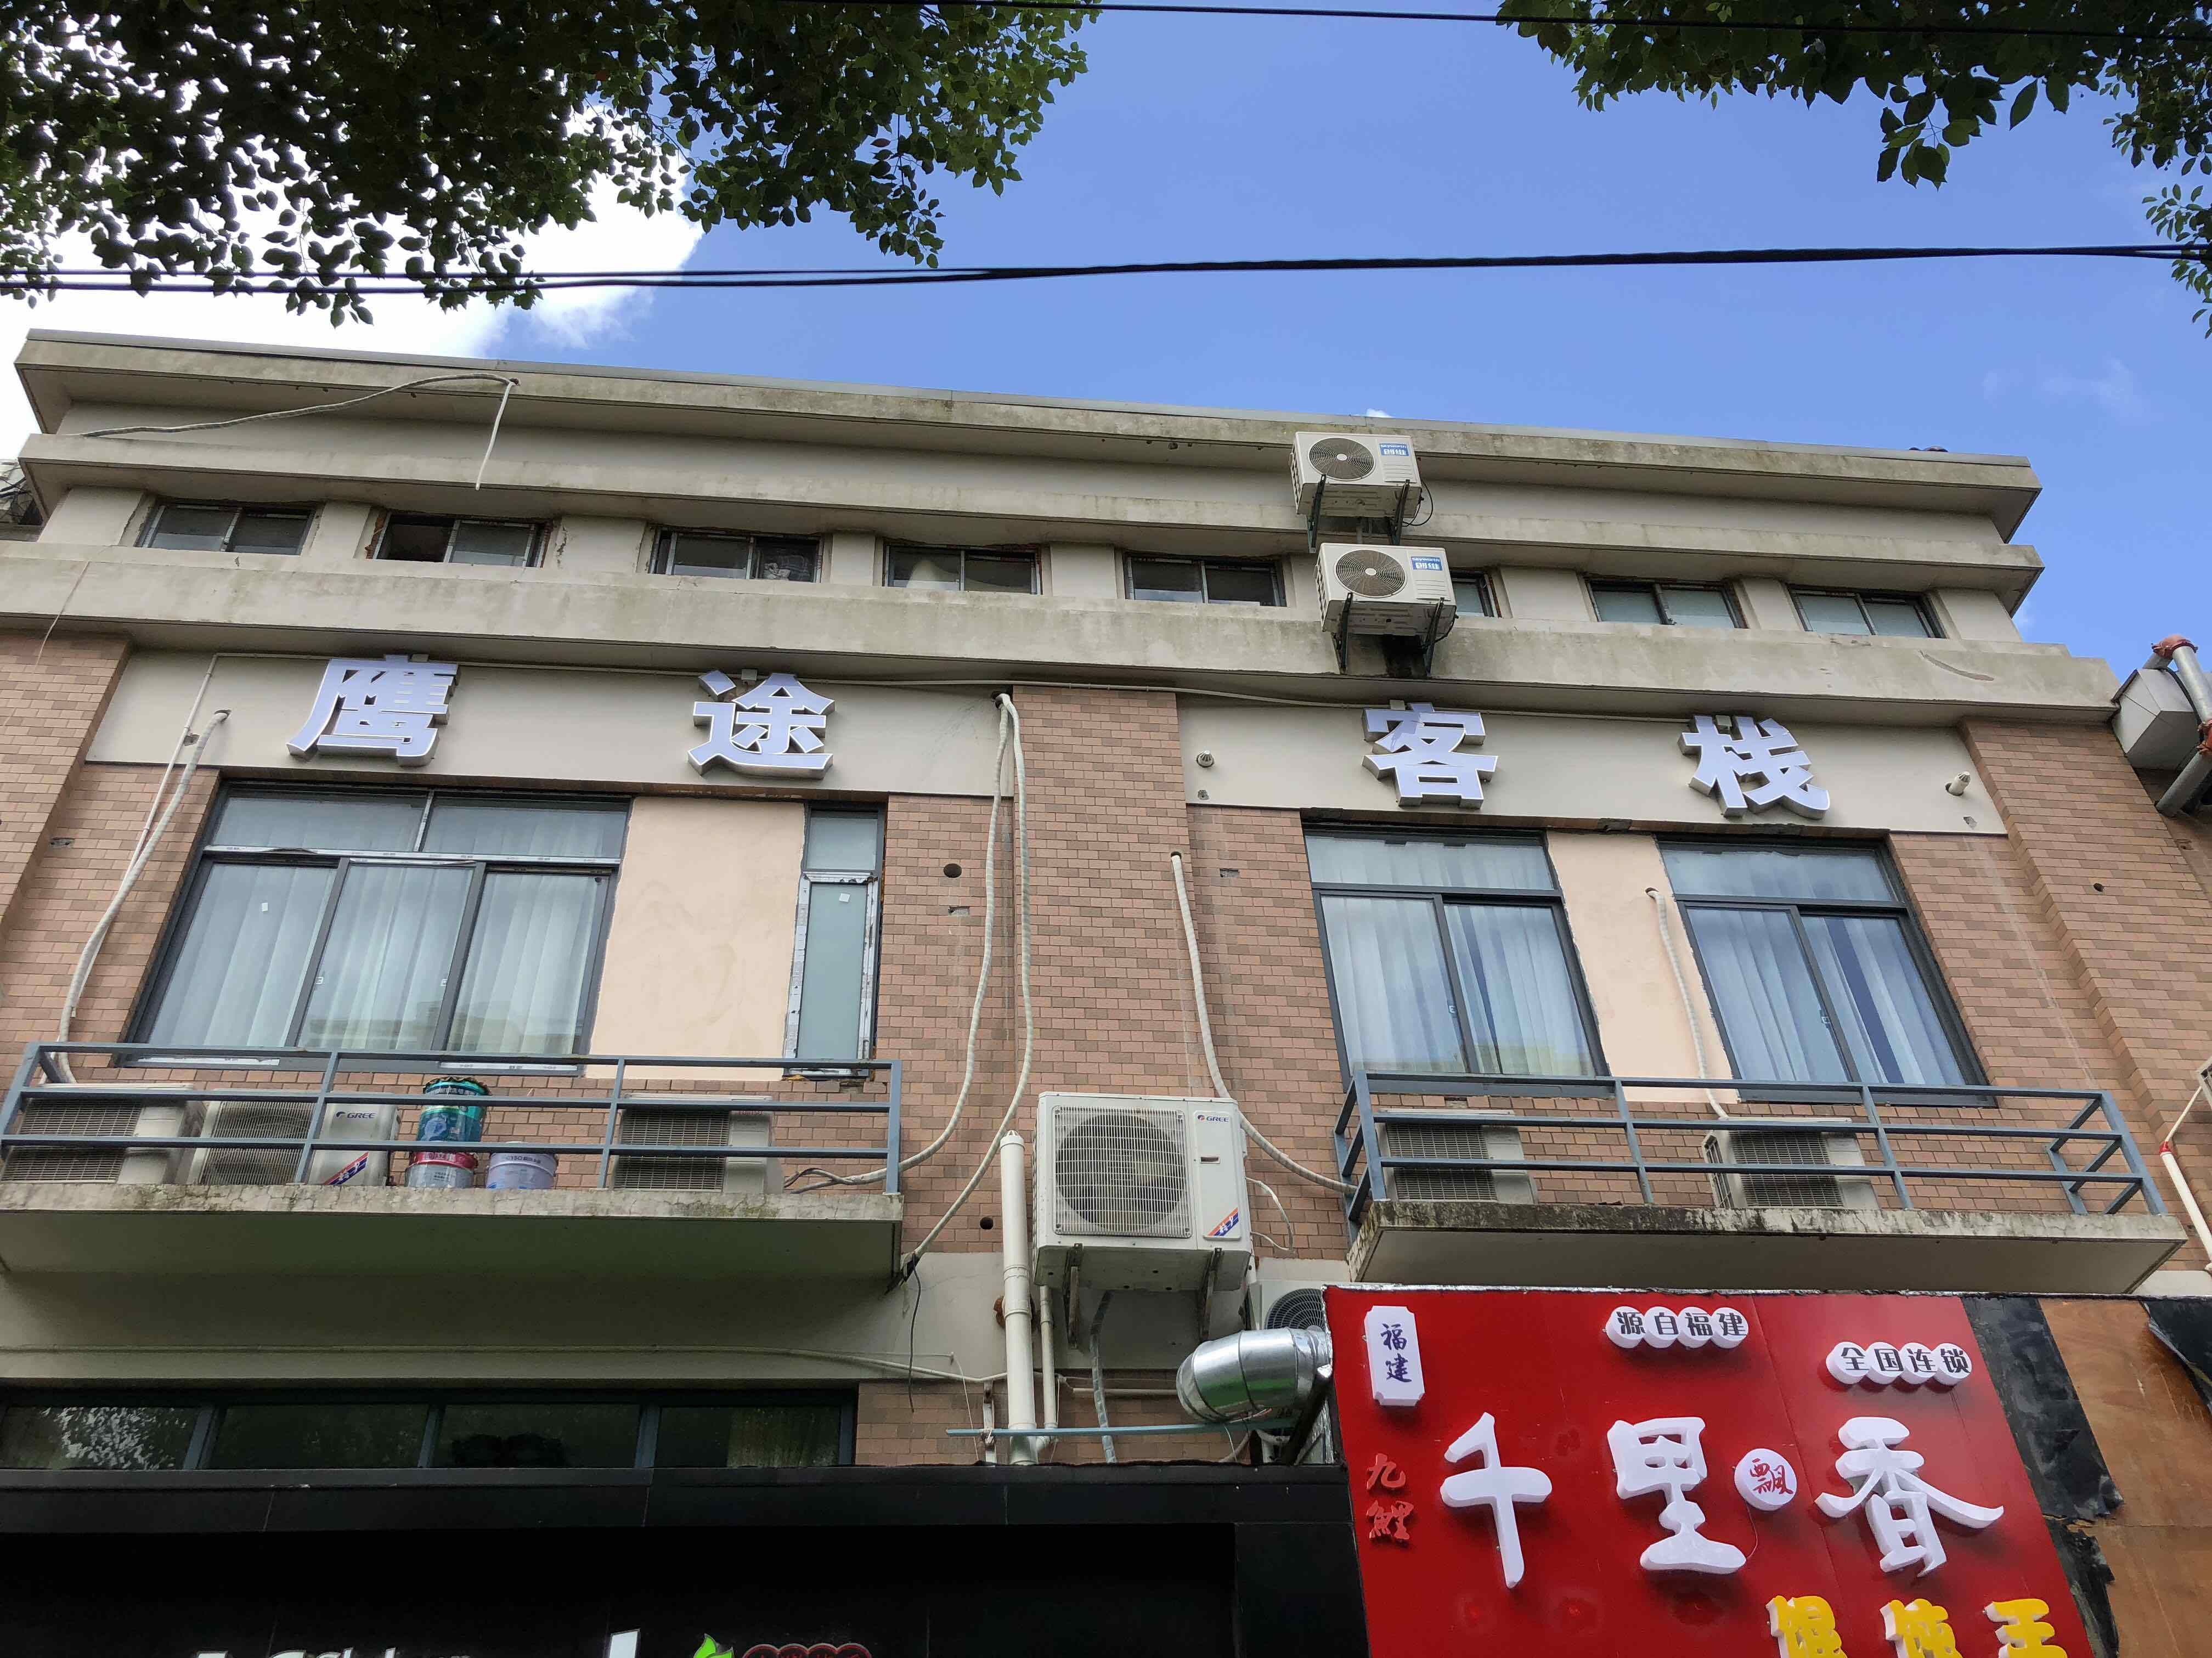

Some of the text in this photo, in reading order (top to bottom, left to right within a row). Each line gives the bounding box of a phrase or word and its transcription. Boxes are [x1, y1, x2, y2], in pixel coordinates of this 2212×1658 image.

[1616, 1311, 1747, 1336] 源自福建
[1380, 1323, 1412, 1383] 福建
[1841, 1346, 1971, 1373] 全国连锁
